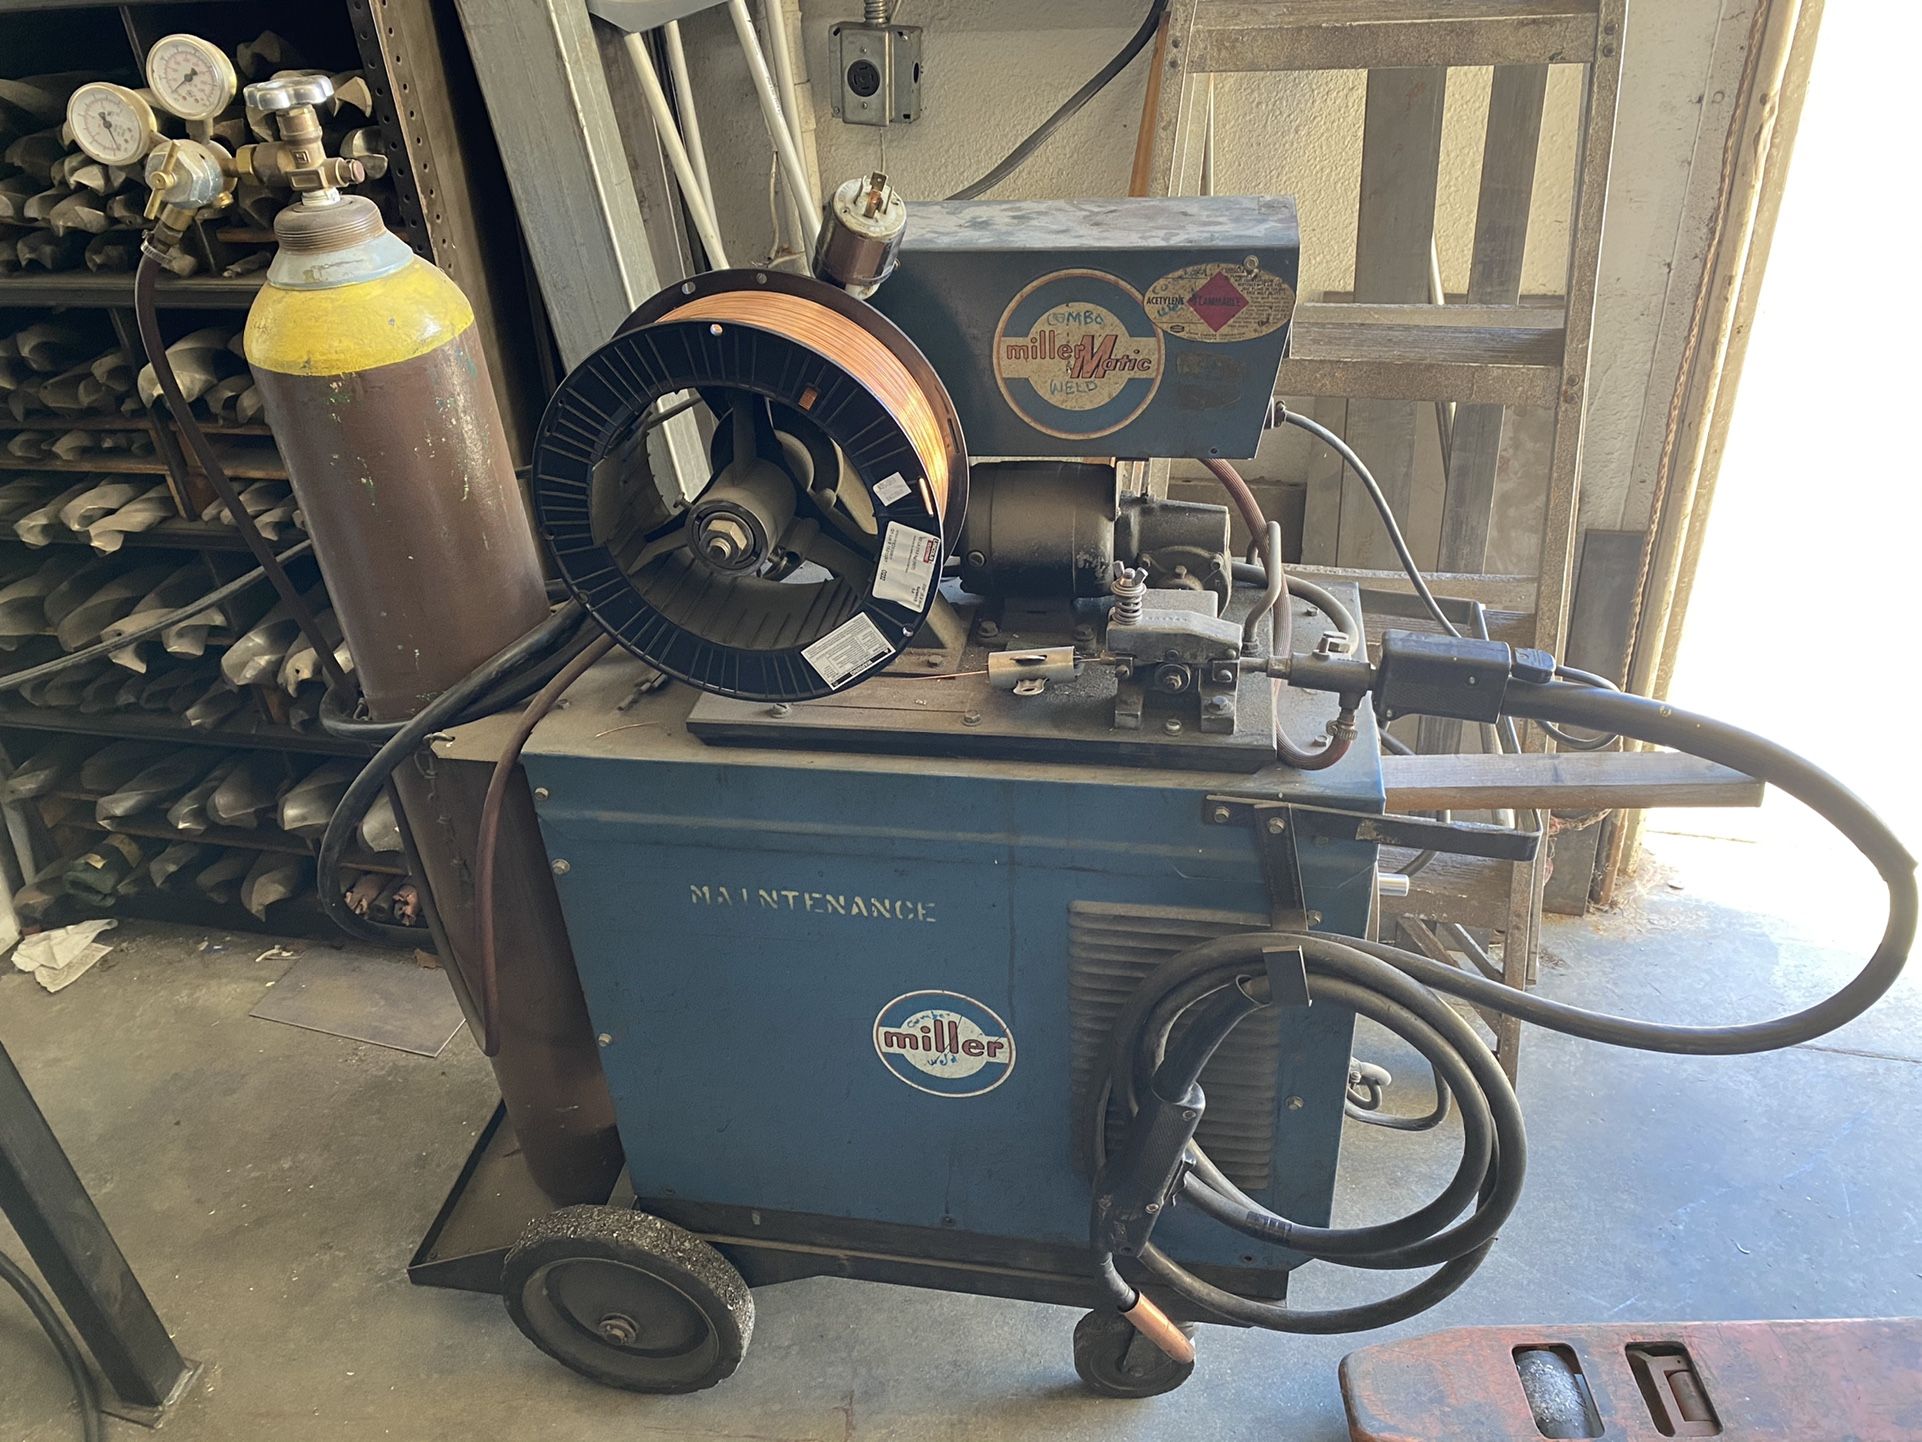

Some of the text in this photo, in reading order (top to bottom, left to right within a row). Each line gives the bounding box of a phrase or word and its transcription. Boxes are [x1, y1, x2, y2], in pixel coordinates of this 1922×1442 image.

[1146, 296, 1185, 305] ACETYLENE
[1047, 310, 1104, 326] COMBO
[1050, 378, 1098, 395] WELD
[690, 884, 937, 923] MAINTENANCE
[884, 1018, 1005, 1058] miller
